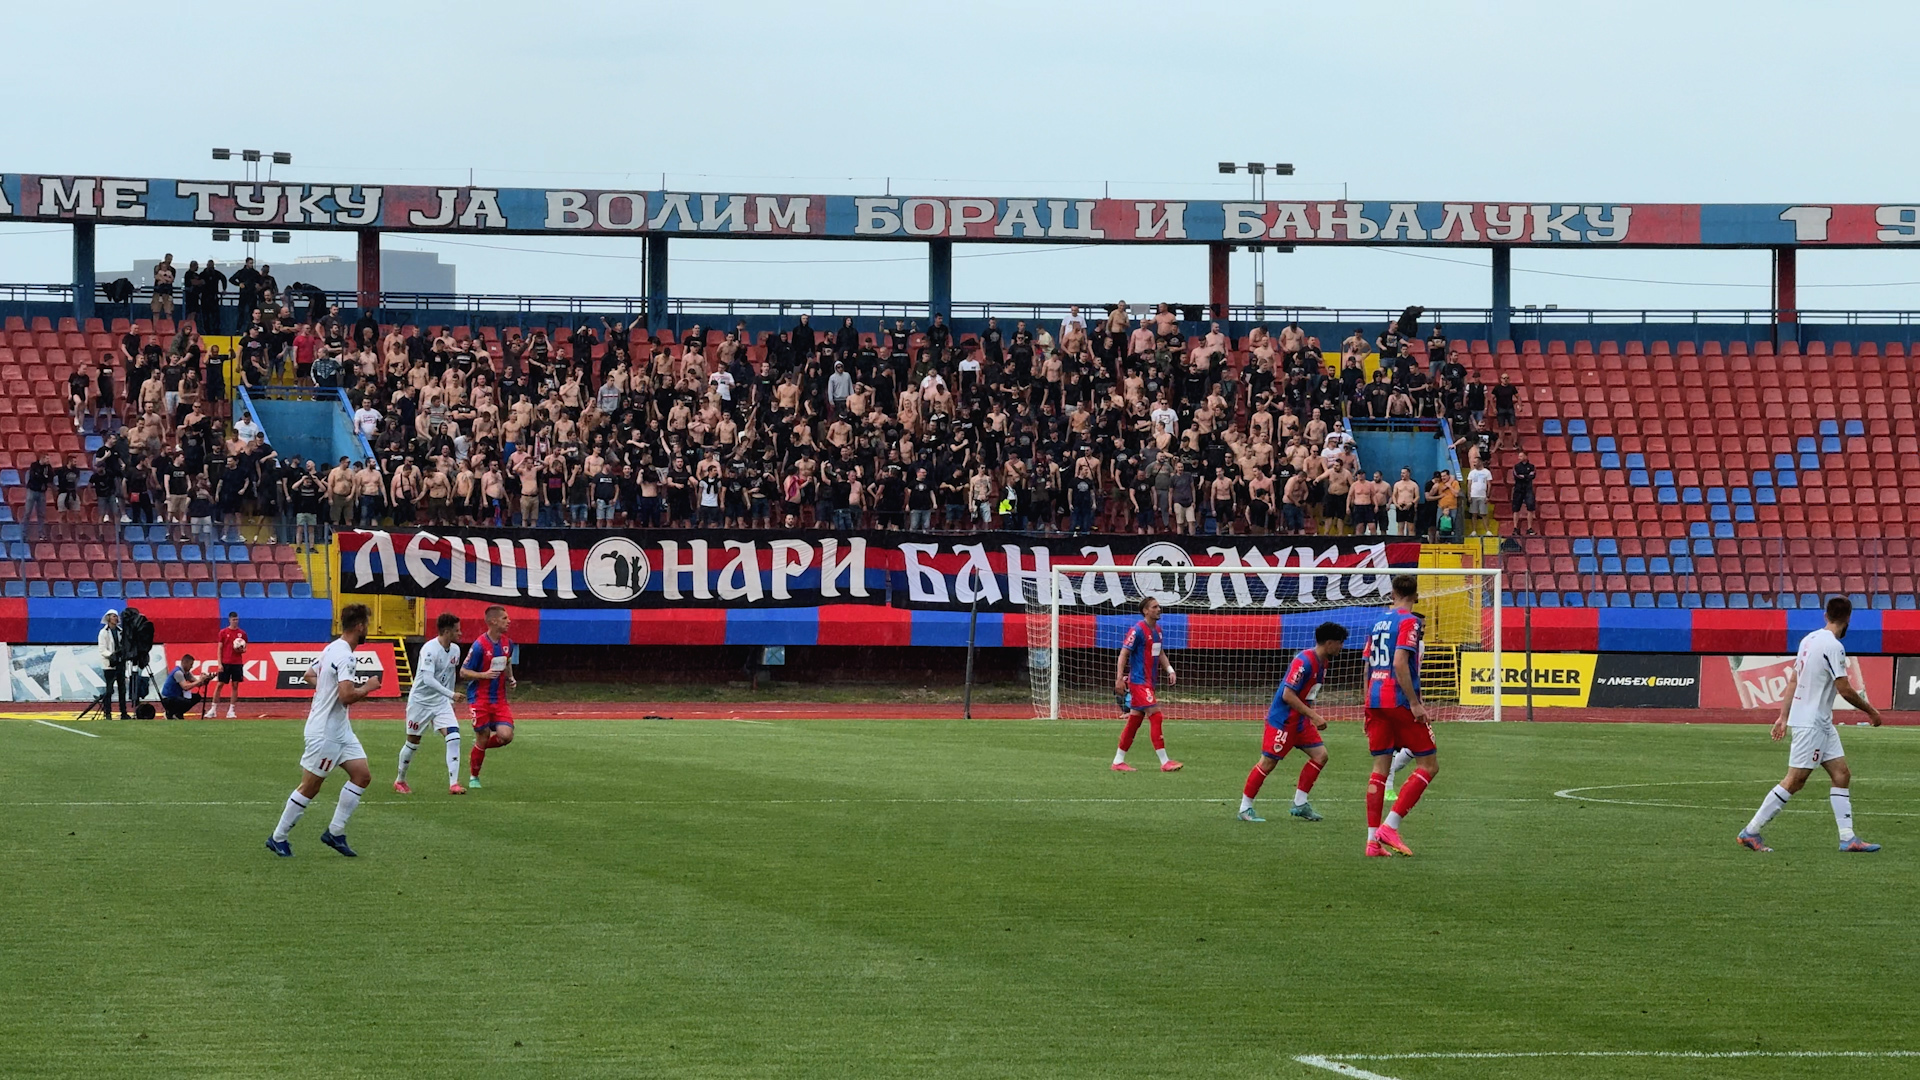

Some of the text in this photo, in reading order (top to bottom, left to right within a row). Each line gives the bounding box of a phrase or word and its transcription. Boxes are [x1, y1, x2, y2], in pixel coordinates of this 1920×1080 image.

[38, 177, 148, 219] МЕ
[176, 181, 384, 226] ТУКУ
[408, 188, 507, 228] ЈА
[544, 190, 812, 234] ВОЛИМ
[854, 197, 1105, 240] БОРАЦ
[1134, 202, 1188, 240] И
[1222, 202, 1633, 242] БАЊАЛУКУ
[1368, 632, 1391, 667] 55
[1655, 677, 1695, 686] GROUP
[408, 720, 419, 731] 96
[1274, 729, 1288, 744] 24
[1812, 749, 1821, 762] 5
[318, 757, 333, 772] 11
